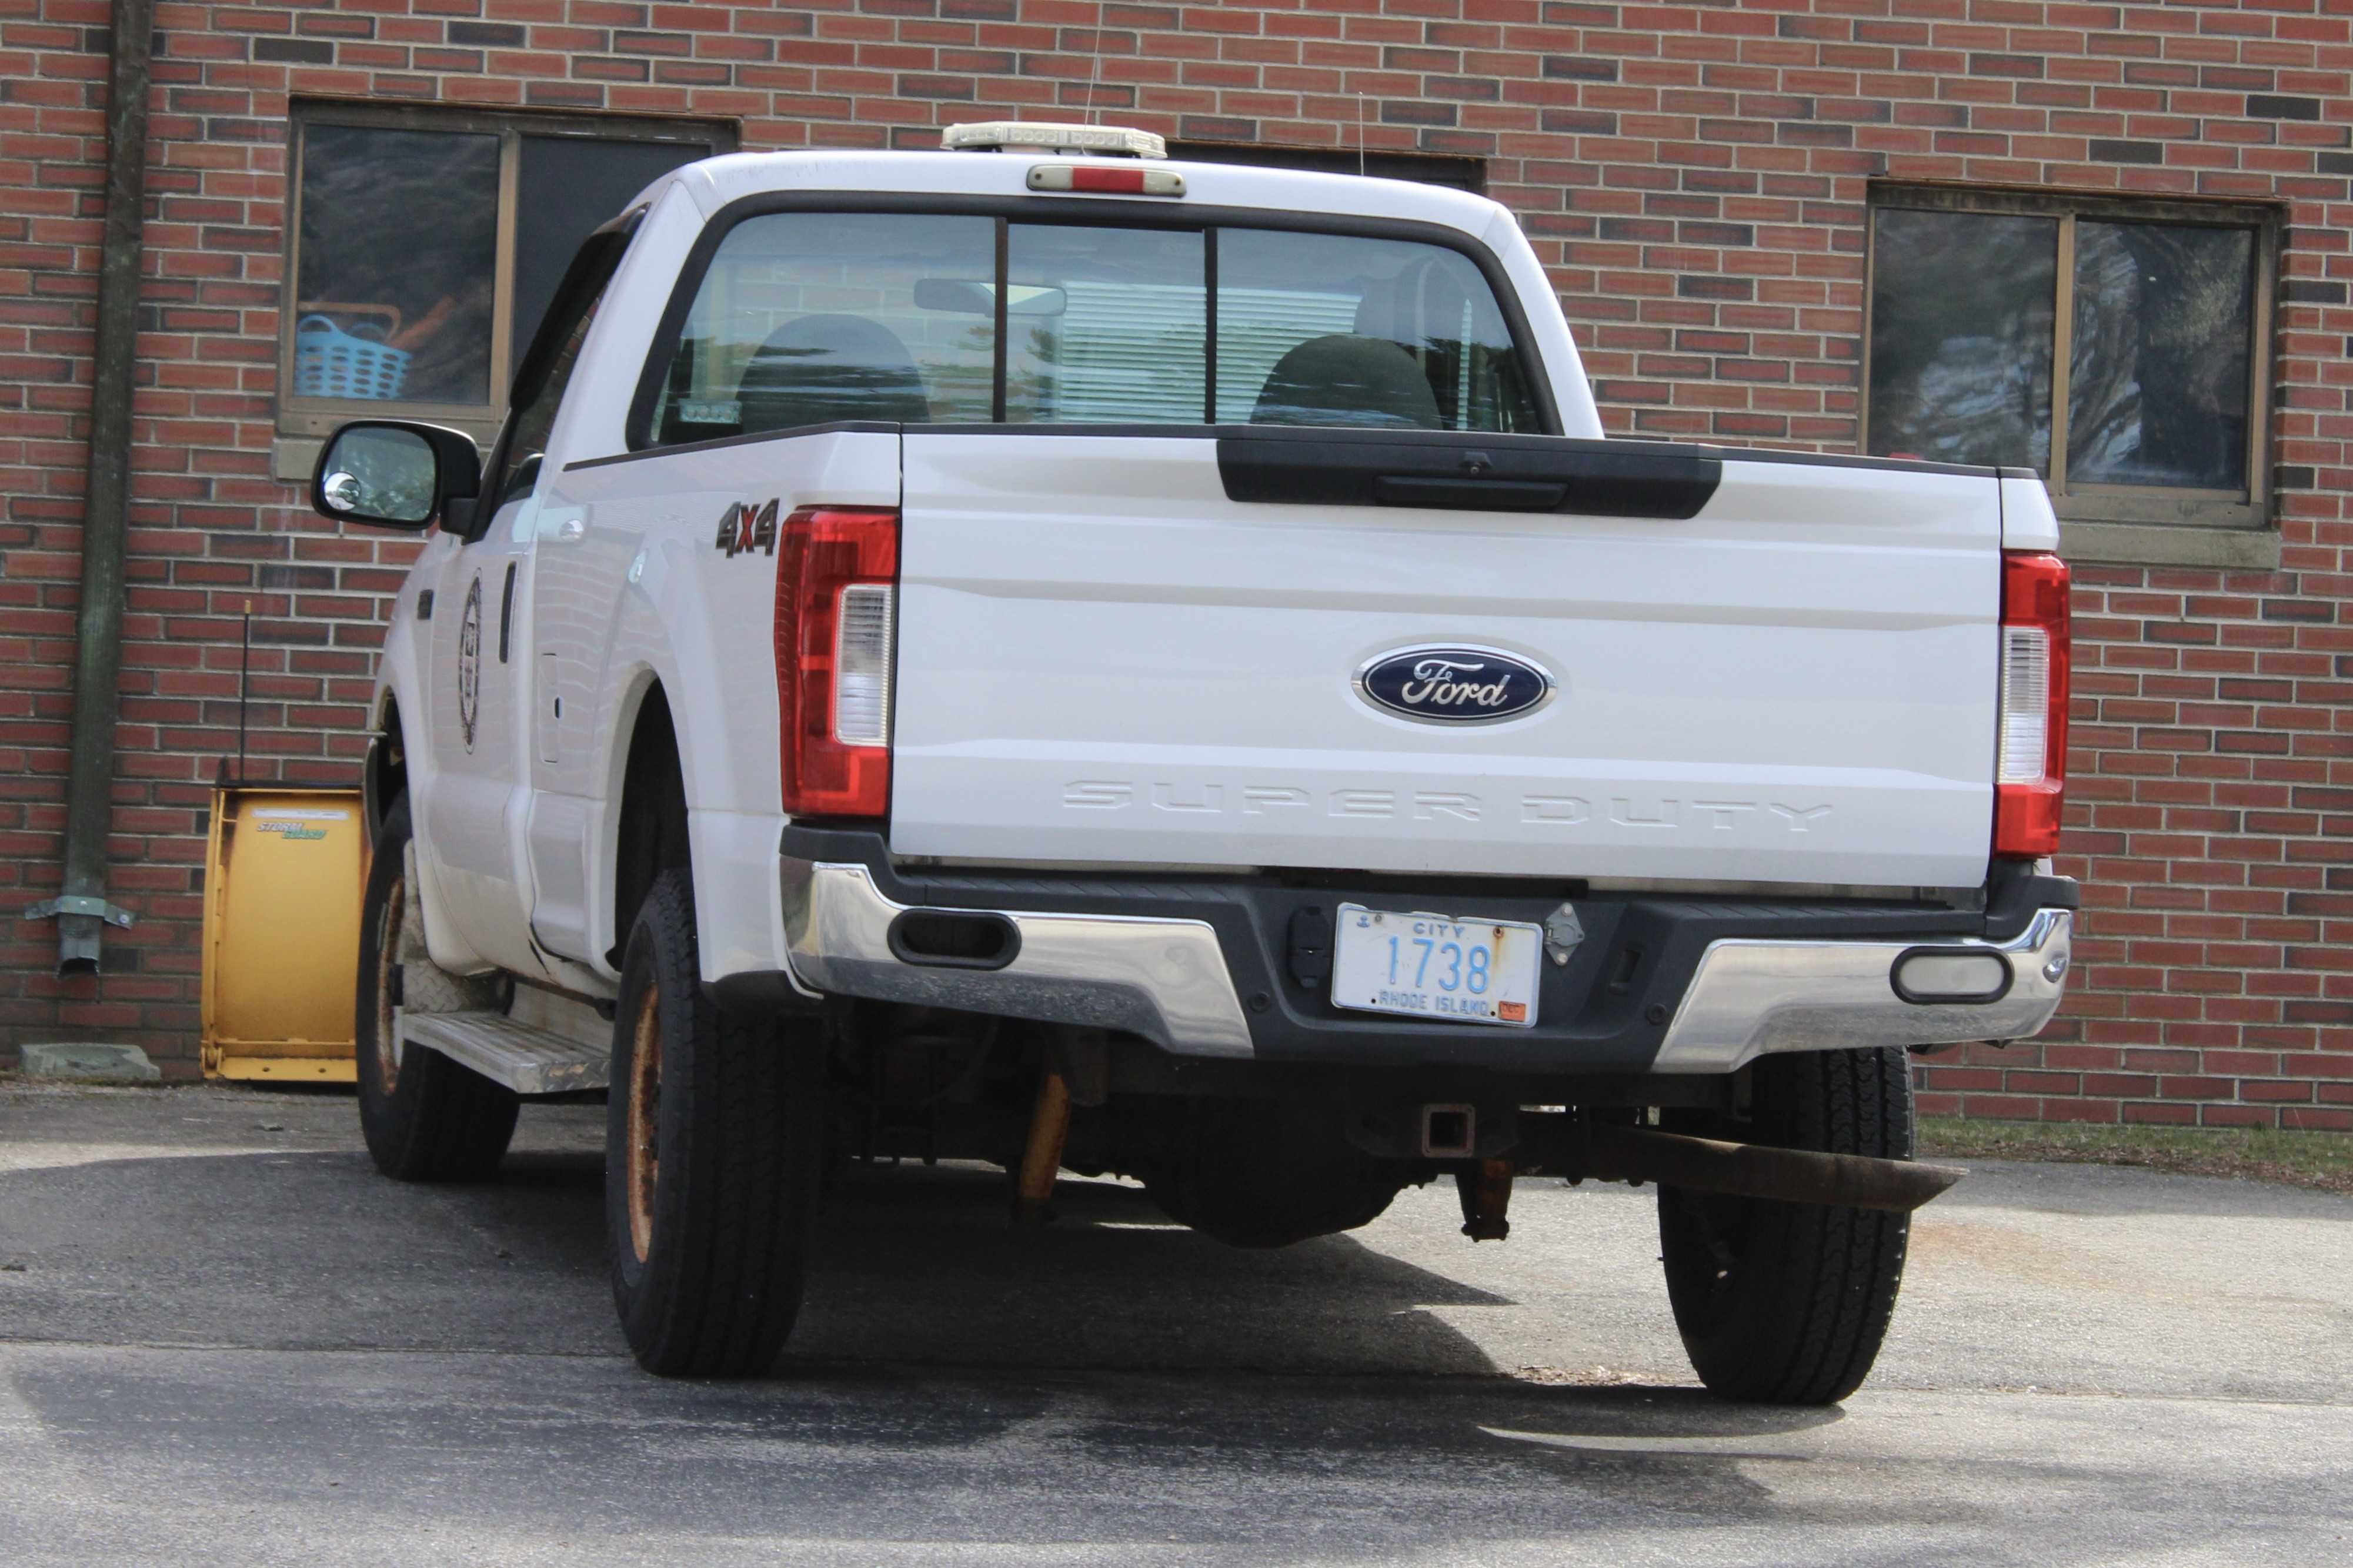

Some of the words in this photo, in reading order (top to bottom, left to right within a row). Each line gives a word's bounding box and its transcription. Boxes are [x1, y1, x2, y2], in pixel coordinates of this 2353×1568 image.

[1401, 659, 1511, 707] Ford
[1063, 780, 1482, 822] SUPER
[1520, 795, 1833, 832] DUTY
[257, 822, 305, 832] STORM
[1413, 921, 1465, 938] CITY
[1389, 935, 1491, 994] 1738
[1380, 989, 1427, 1009] RHODE
[1436, 995, 1489, 1016] ISLAND
